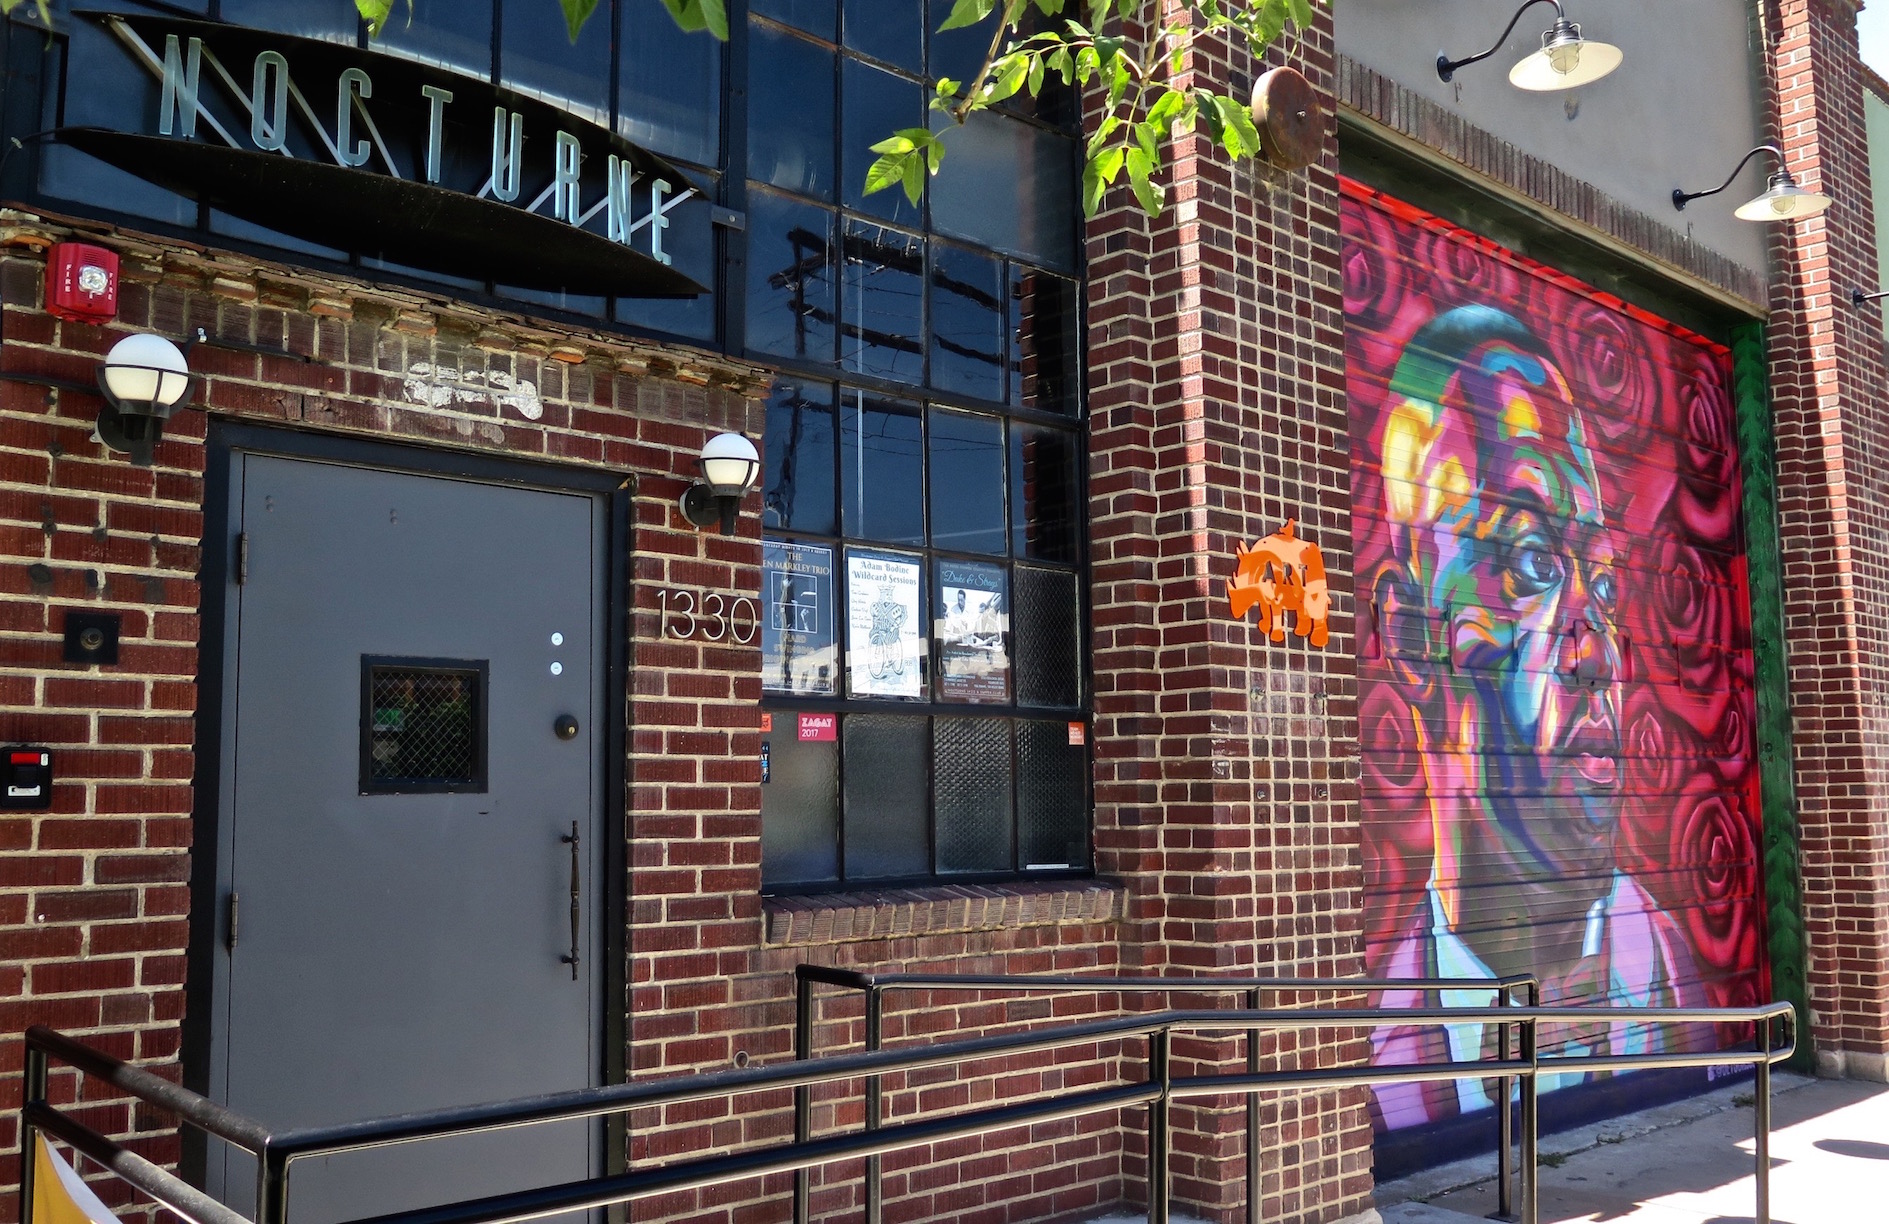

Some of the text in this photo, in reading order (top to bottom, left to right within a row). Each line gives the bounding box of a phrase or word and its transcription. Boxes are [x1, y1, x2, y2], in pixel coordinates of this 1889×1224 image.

[159, 34, 672, 266] NOCTURNE
[786, 551, 803, 561] THE
[762, 559, 830, 576] EN MARKLEY TRIO
[860, 560, 910, 574] Adam Bodine
[851, 570, 917, 586] Wildcard Sessions
[656, 588, 757, 645] 1330
[801, 717, 833, 728] ZAGAT
[801, 728, 819, 737] 2017
